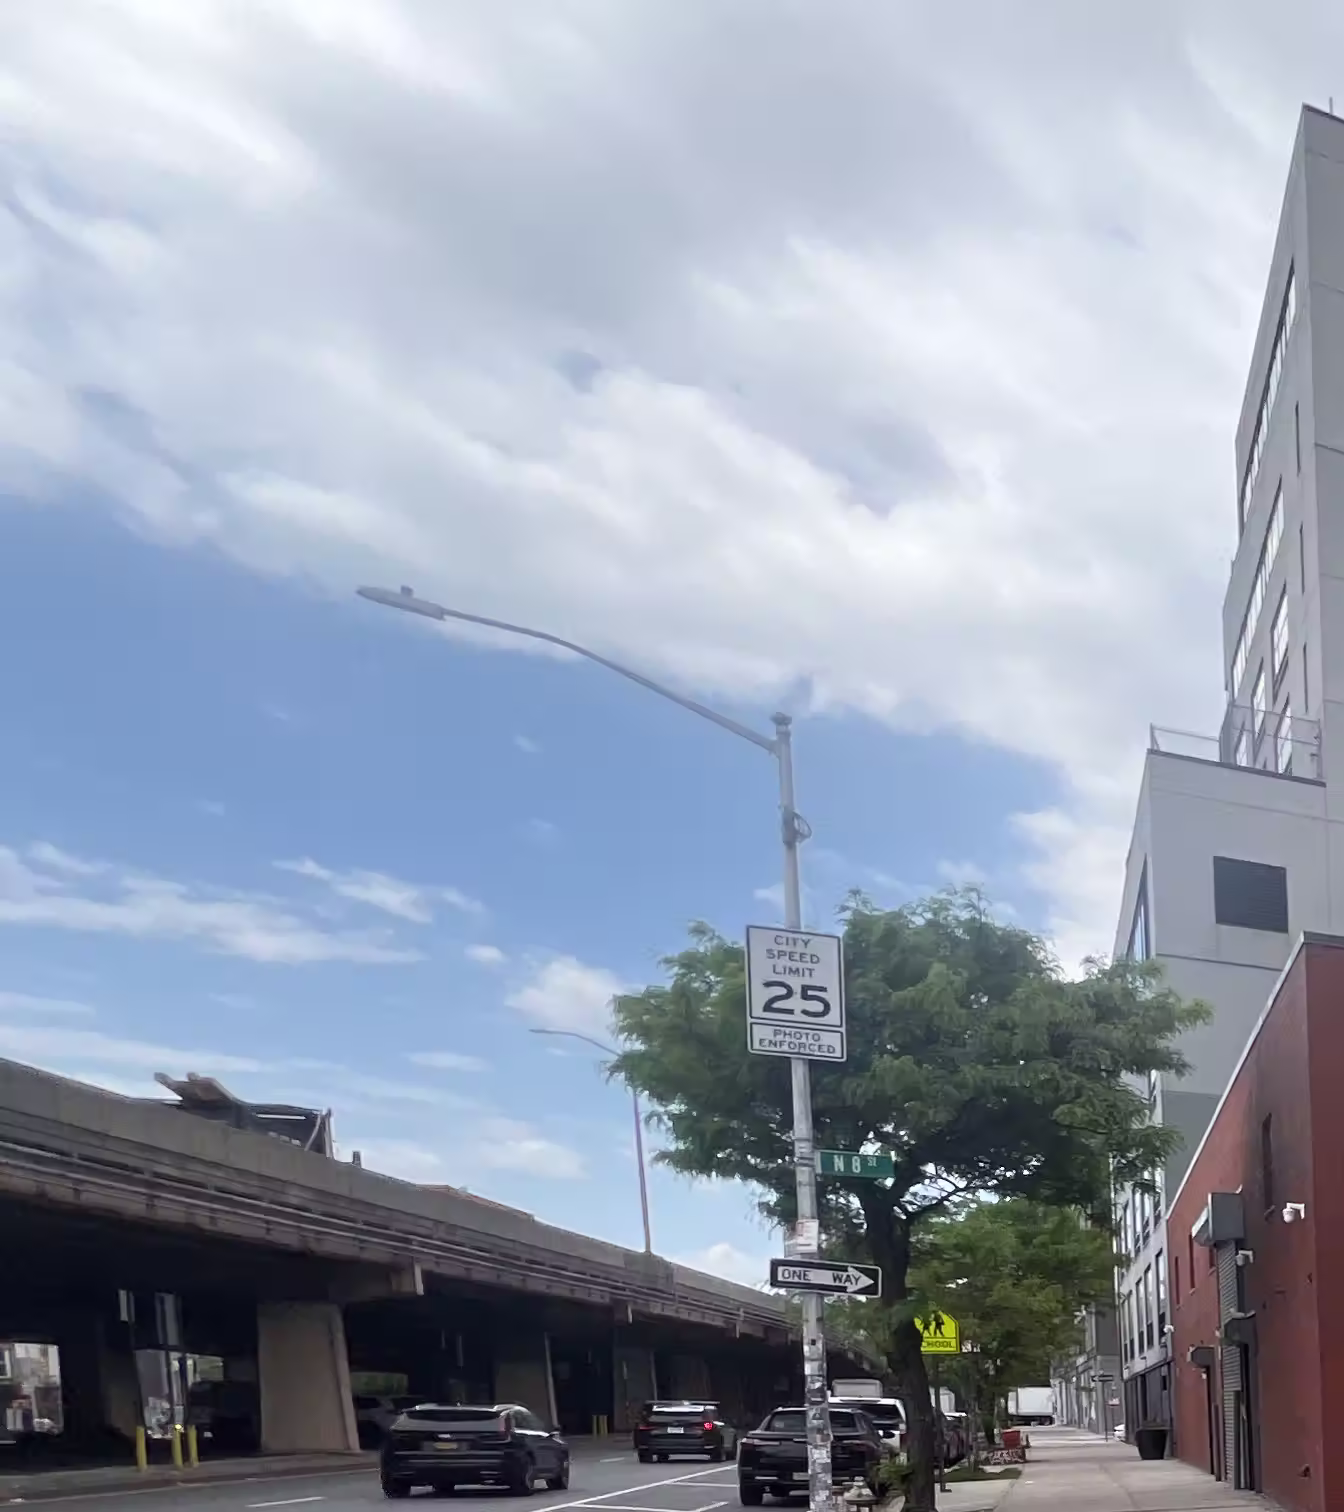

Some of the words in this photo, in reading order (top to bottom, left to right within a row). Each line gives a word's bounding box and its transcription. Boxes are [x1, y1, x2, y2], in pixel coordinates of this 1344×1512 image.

[774, 935, 812, 949] CITY
[766, 948, 820, 964] SPEED
[772, 964, 815, 978] LIMIT
[762, 980, 831, 1018] 25
[773, 1029, 821, 1042] PHOTO
[759, 1038, 836, 1054] ENFORCED
[833, 1155, 844, 1172] N
[852, 1156, 861, 1173] 8
[781, 1268, 811, 1281] ONE
[832, 1272, 862, 1286] WAY
